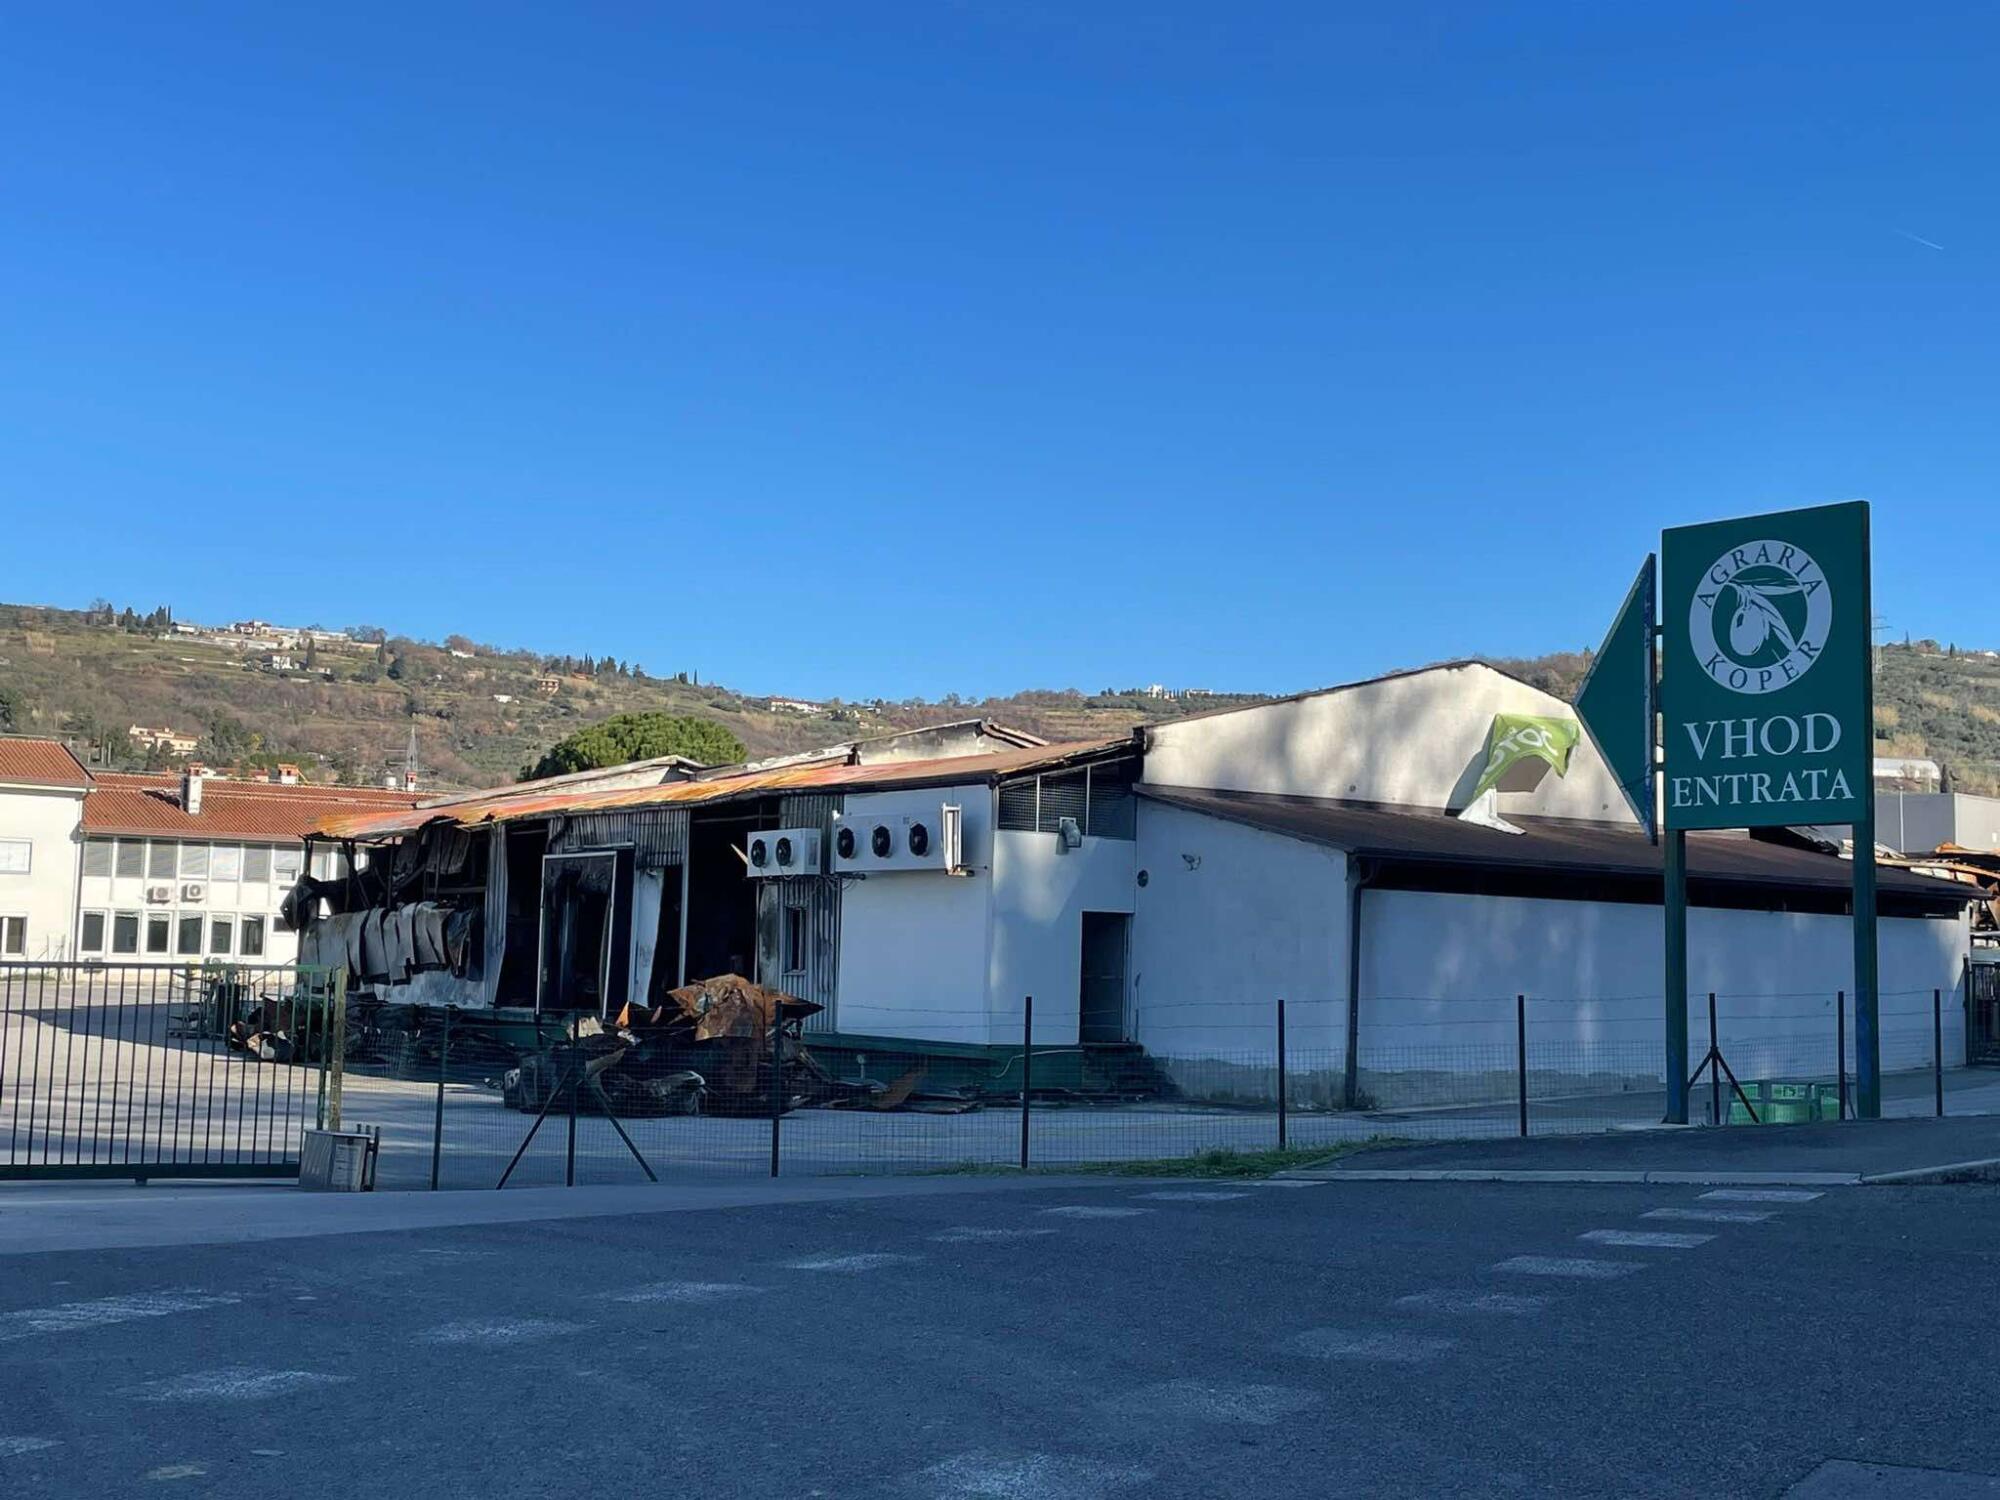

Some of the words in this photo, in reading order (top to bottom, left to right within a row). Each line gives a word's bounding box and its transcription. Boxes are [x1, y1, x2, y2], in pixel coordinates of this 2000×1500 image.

[1697, 543, 1823, 609] AGRARIA
[1705, 640, 1821, 691] KOPER
[1682, 713, 1842, 761] VHOD
[1671, 768, 1856, 807] ENTRATA
